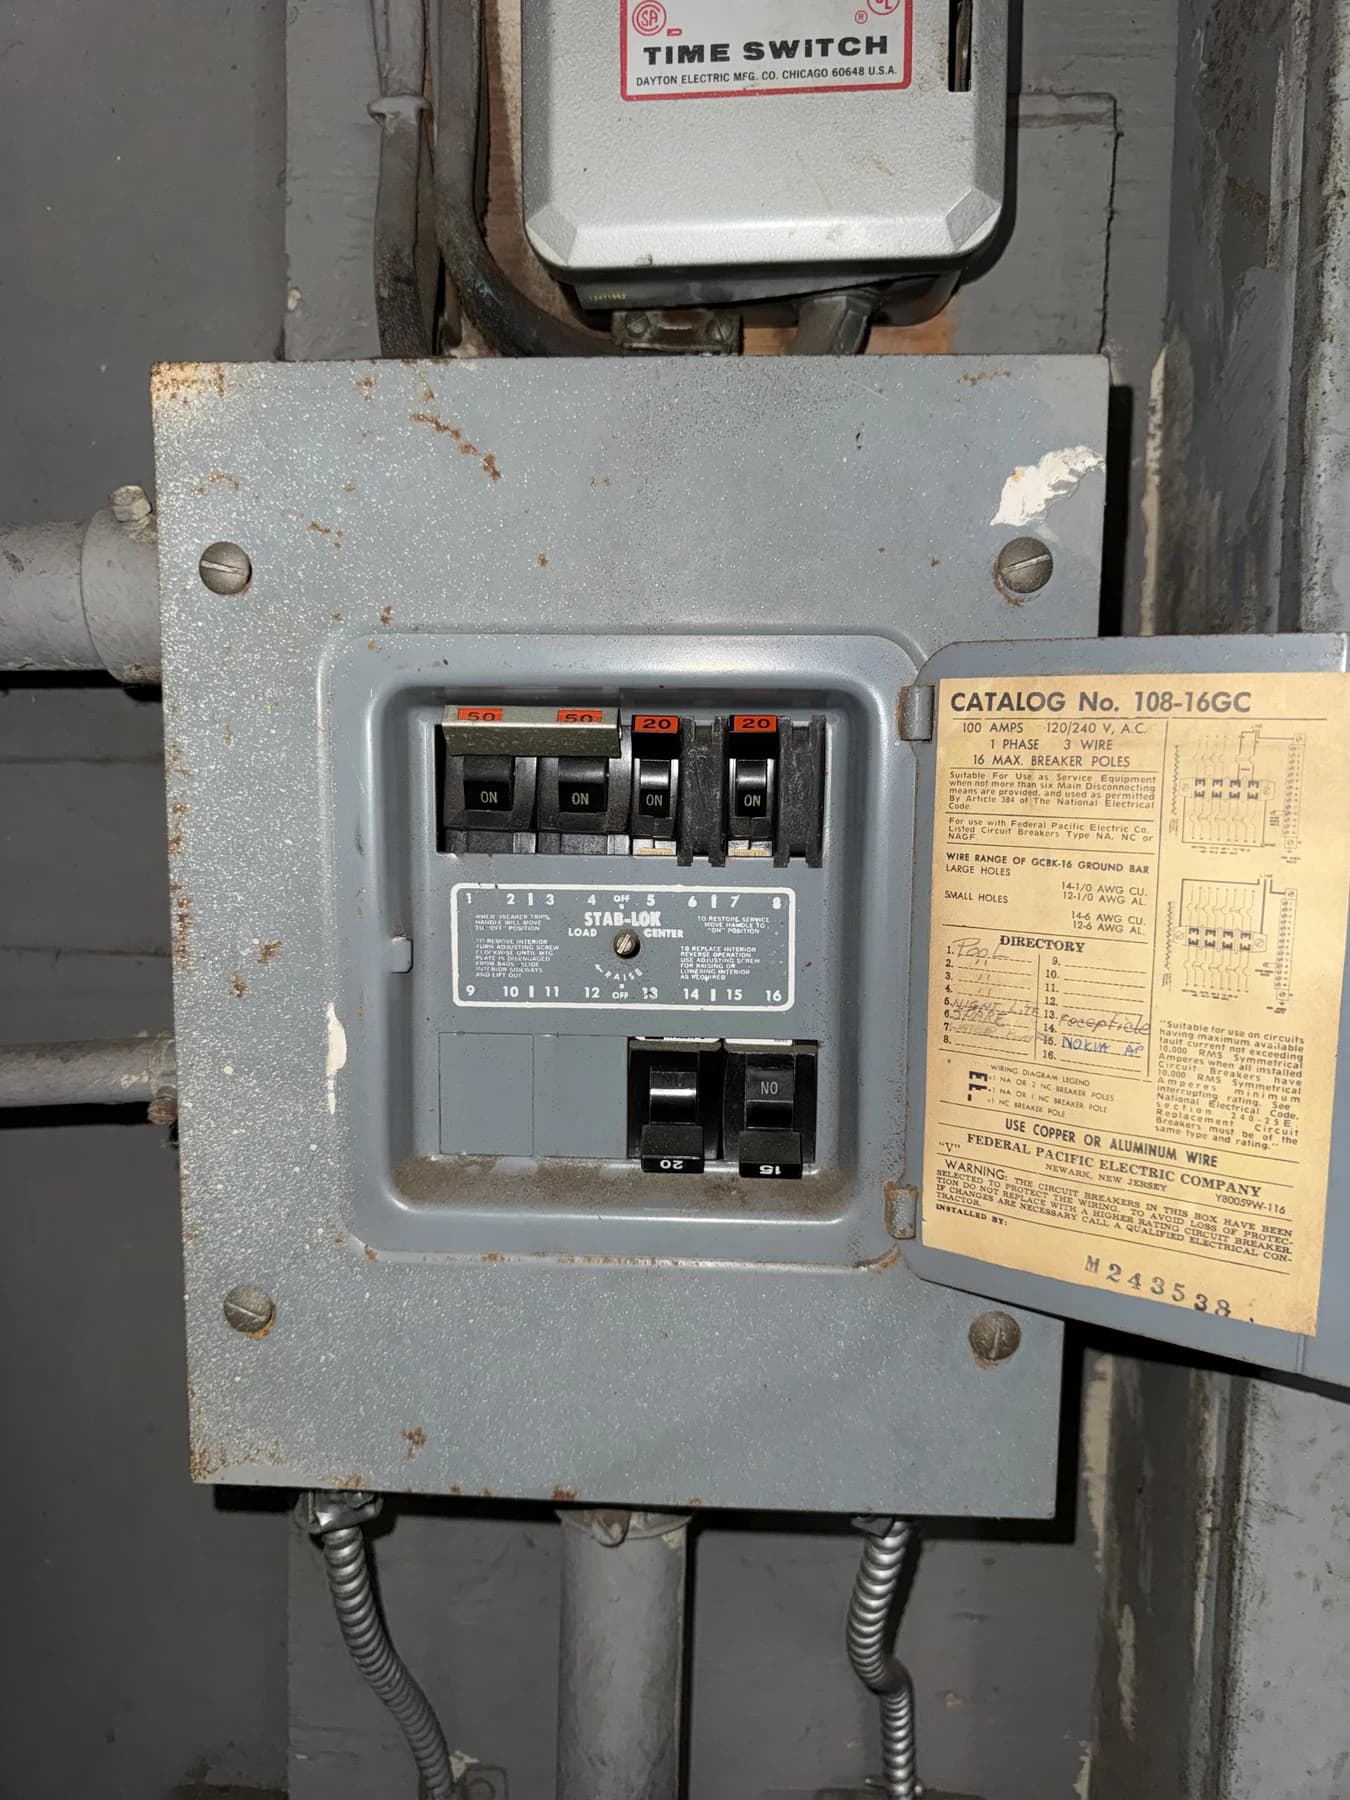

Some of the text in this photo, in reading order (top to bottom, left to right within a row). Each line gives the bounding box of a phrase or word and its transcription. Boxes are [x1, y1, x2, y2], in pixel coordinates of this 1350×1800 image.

[643, 35, 888, 65] TIME SWITCH
[636, 65, 896, 86] DAYTON ELECTRIC MFG. CO. CHICAGO 60648 U.S.A.
[951, 691, 1252, 712] CATALOG No. 108-16GC
[467, 712, 495, 721] 50
[565, 714, 593, 723] 50
[643, 719, 671, 729] 20
[742, 719, 770, 729] 20
[963, 723, 981, 733] 100
[989, 723, 1024, 733] AMPS
[1047, 721, 1096, 736] 120/240
[1121, 723, 1146, 734] A.C.
[991, 739, 1113, 750] 1 PHASE 3 WIRE
[974, 754, 1130, 767] 16 MAX. BREAKER POLES
[1101, 775, 1156, 784] Equipment
[481, 791, 497, 803] ON
[572, 793, 589, 805] ON
[646, 794, 663, 806] ON
[744, 794, 761, 807] ON
[949, 817, 963, 825] For
[1011, 820, 1046, 828] Federal
[1052, 822, 1084, 830] Pacific
[1090, 824, 1128, 833] Electric
[946, 864, 1011, 876] LARGE HOLES
[947, 852, 969, 861] WIRE
[975, 855, 1007, 864] RANGE
[1013, 857, 1026, 865] OF
[1078, 861, 1123, 872] GROUND
[1129, 865, 1149, 874] BAR
[1062, 881, 1148, 896] 14-1/0 AWG CU.
[466, 892, 471, 904] 1
[507, 893, 515, 904] 2
[546, 894, 554, 905] 3
[587, 894, 596, 906] 4
[646, 894, 655, 906] 5
[688, 896, 697, 908] 6
[730, 895, 740, 907] 7
[772, 897, 781, 909] 8
[944, 890, 1008, 904] SMALL HOLES
[1063, 891, 1093, 901] 12-1/0
[1098, 895, 1125, 904] AWG
[584, 911, 661, 927] STAB-LOK
[1072, 911, 1146, 925] 14-6 AWG CU.
[568, 928, 684, 938] LOAD CENTER
[1073, 921, 1092, 930] 12-6
[1097, 924, 1123, 933] AWG
[1000, 935, 1086, 952] DIRECTORY
[466, 985, 475, 996] 9
[503, 986, 519, 997] 10
[545, 986, 559, 997] 11
[584, 987, 600, 998] 12
[642, 987, 658, 999] 13
[683, 988, 699, 1000] 14
[727, 989, 742, 1000] 15
[766, 989, 782, 1002] 16
[1211, 1025, 1224, 1034] for
[1228, 1029, 1245, 1038] use
[1248, 1031, 1260, 1039] on
[1263, 1032, 1304, 1045] circuits
[990, 1064, 1090, 1087] WIRING DIAGRAM LEGEND
[761, 1081, 778, 1095] ON
[1005, 1118, 1218, 1168] USE COPPER OR ALUMINUM WIRE
[660, 1159, 684, 1170] 20
[759, 1165, 782, 1175] 15
[967, 1133, 1262, 1198] FEDERAL PACIFIC ELECTRIC COMPANY
[1098, 1173, 1122, 1184] NEW
[1127, 1178, 1168, 1193] JERSEY
[945, 1159, 1293, 1238] WARNING: THE CIRCUIT BREAKERS IN THIS BOX HAVE BEEN
[936, 1203, 1008, 1226] INSTALLED BY:
